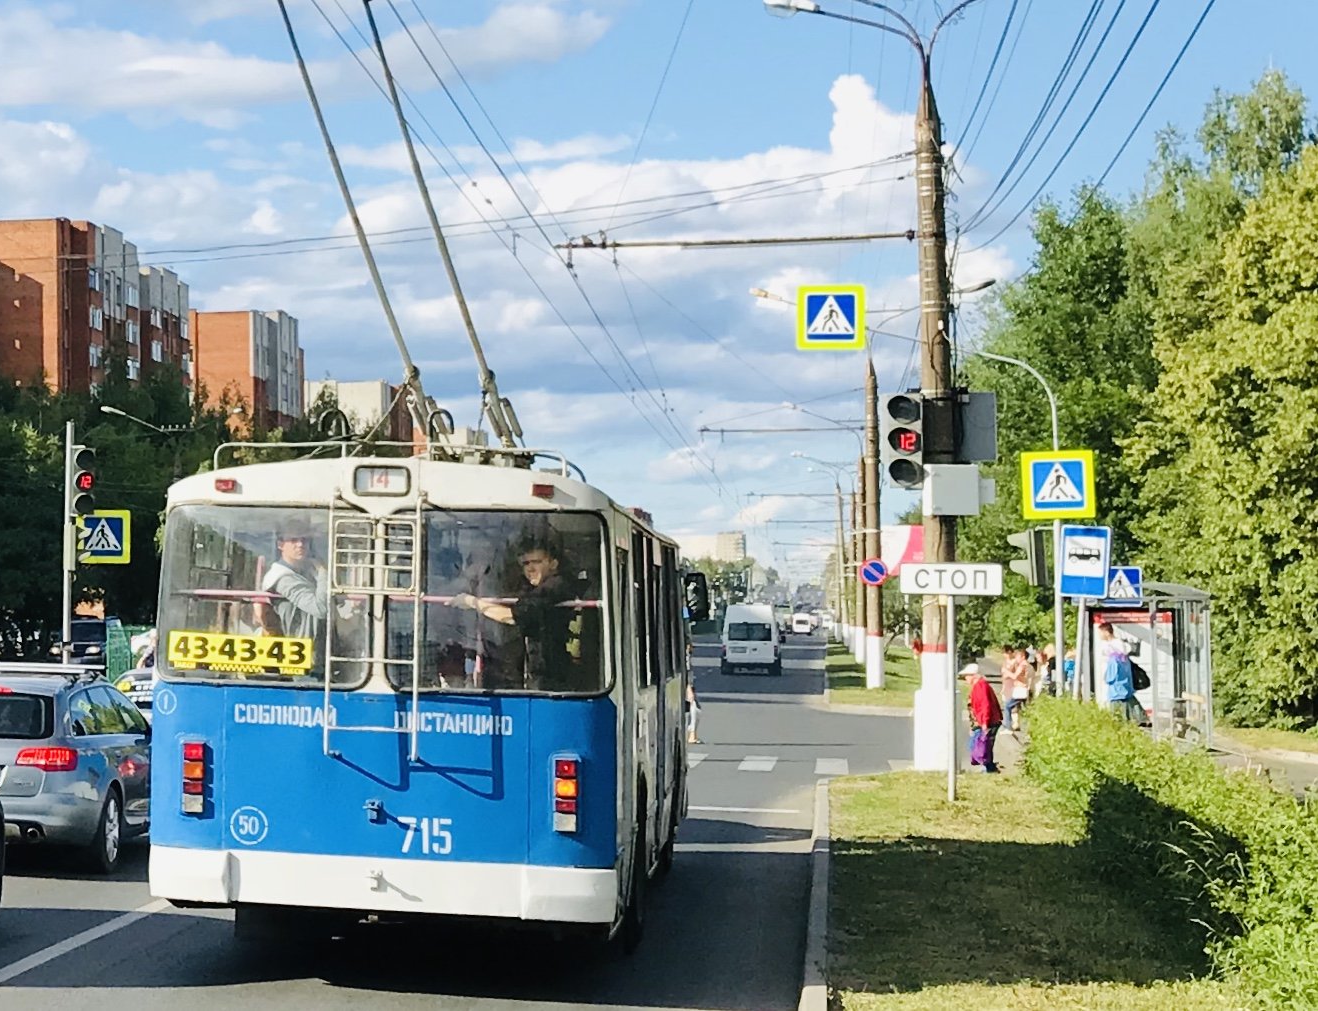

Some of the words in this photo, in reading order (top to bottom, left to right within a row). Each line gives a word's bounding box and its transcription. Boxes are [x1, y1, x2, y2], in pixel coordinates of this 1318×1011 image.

[900, 432, 916, 450] 12
[80, 475, 92, 488] 12
[915, 568, 987, 590] СТОП
[234, 703, 337, 728] СОБЛЮДАЙ
[394, 710, 513, 736] ДИСТАНЦИЮ
[238, 815, 259, 835] 50
[397, 816, 452, 854] 715
